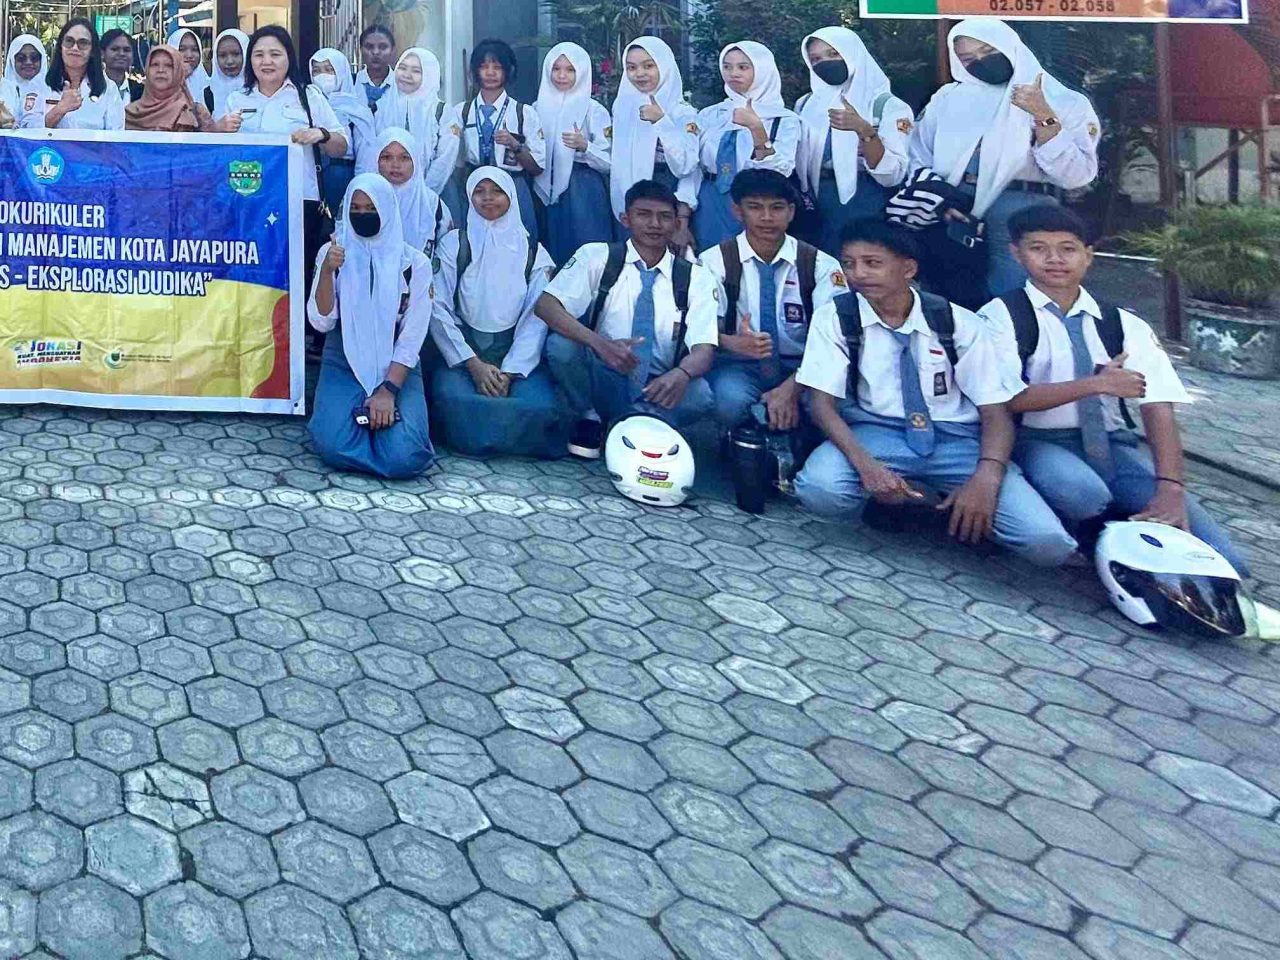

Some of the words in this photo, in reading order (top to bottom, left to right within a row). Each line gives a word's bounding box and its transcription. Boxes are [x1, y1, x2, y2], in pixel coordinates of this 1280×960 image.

[989, 0, 1045, 12] 02.057
[1060, 0, 1115, 12] 02.058
[8, 232, 115, 260] MANAJEMEN
[121, 238, 166, 262] KOTA
[170, 239, 259, 265] JAYAPURA
[27, 265, 132, 293] EKSPLORASI
